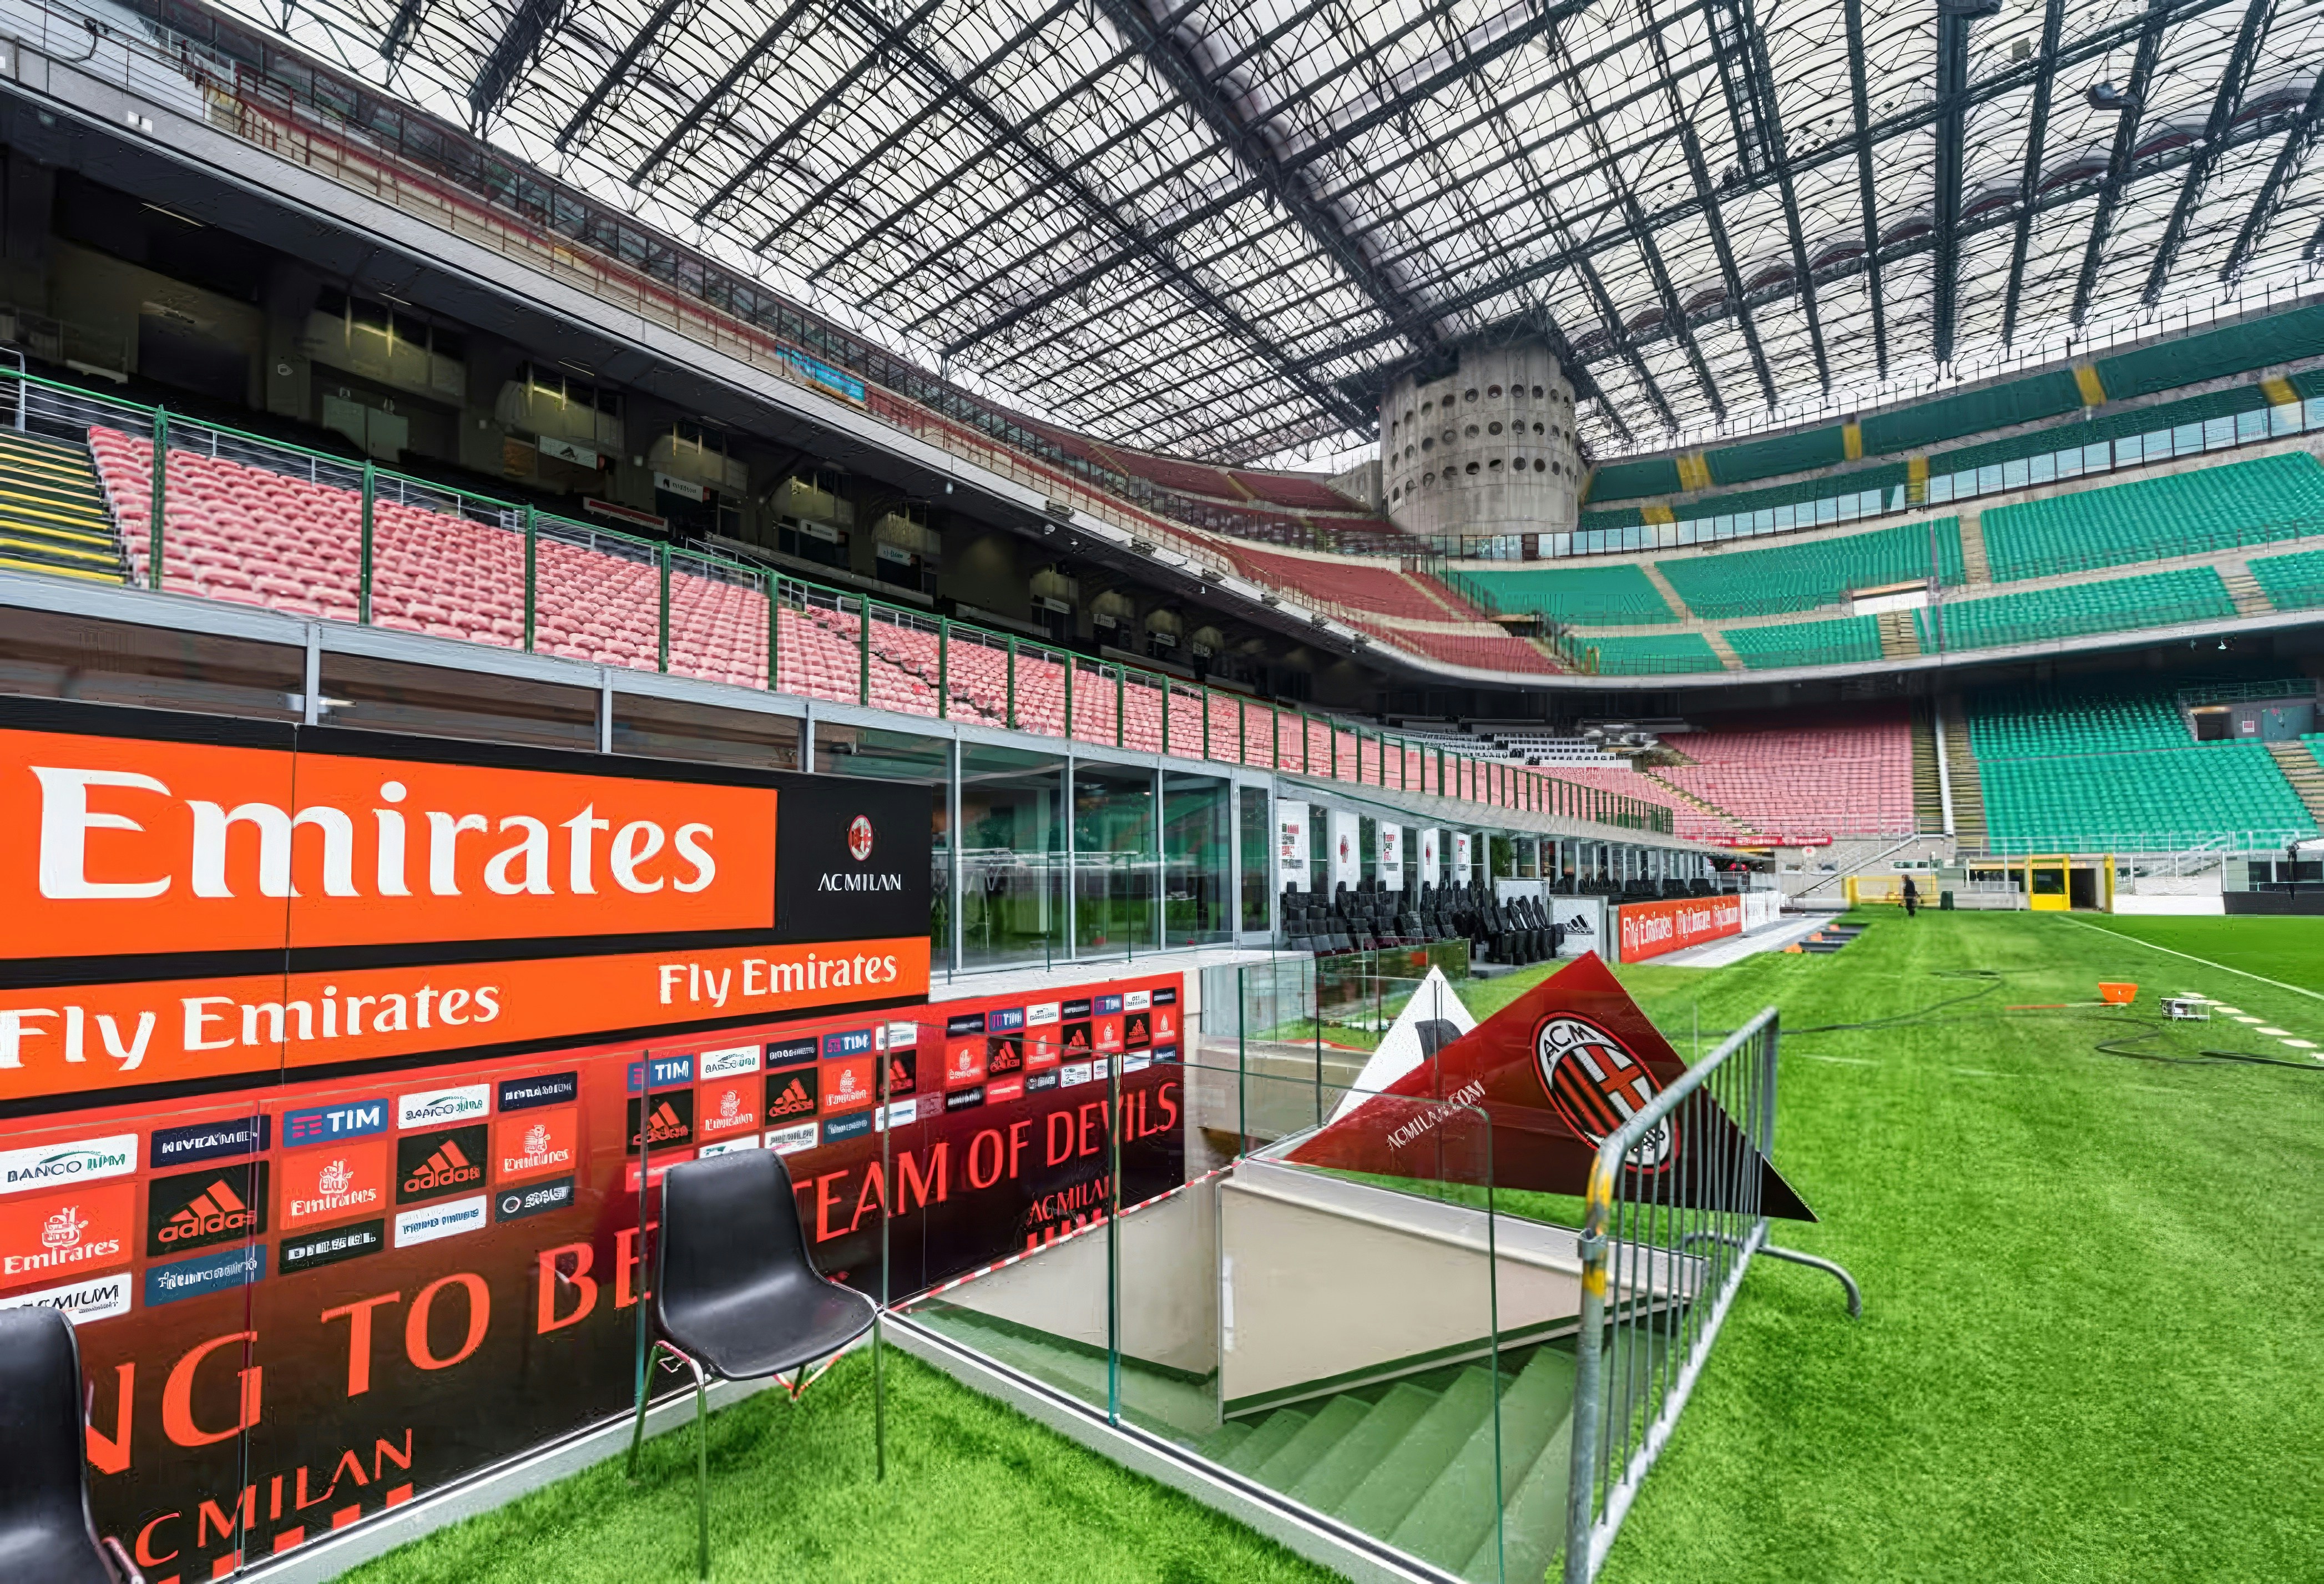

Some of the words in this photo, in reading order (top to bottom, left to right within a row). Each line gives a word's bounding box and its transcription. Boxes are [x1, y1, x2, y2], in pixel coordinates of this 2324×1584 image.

[28, 766, 716, 899] Emirates
[659, 963, 731, 1008] Fly
[743, 952, 897, 997] Emirates
[0, 1006, 157, 1071] Fly
[181, 985, 501, 1051] Emirates
[655, 1061, 689, 1081] TIM
[326, 1106, 381, 1132] TIM
[321, 1273, 490, 1397] TO
[537, 1221, 659, 1334] BE
[968, 1120, 1032, 1189] OF
